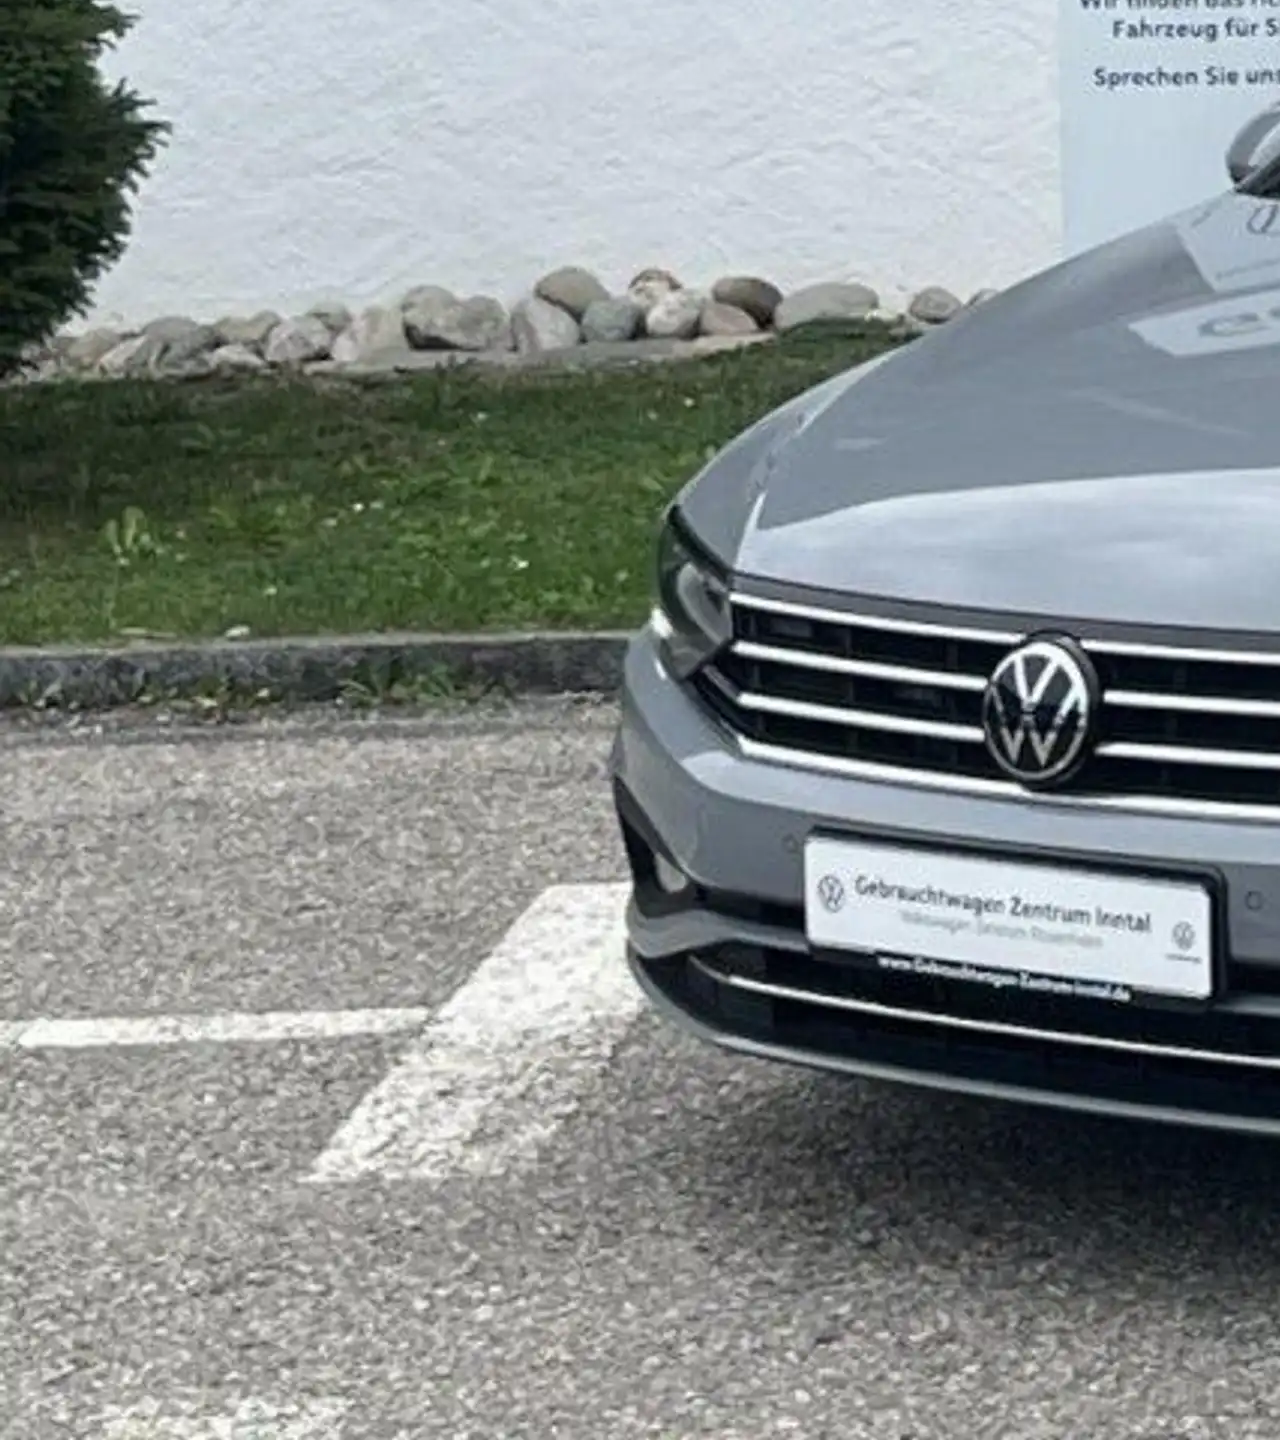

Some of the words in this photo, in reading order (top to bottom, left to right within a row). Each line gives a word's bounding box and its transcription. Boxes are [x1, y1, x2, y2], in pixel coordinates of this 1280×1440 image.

[1112, 19, 1218, 42] Fahrzeug
[1224, 17, 1260, 38] für
[1094, 67, 1198, 90] Sprechen
[1204, 66, 1239, 86] Sie
[854, 874, 1006, 917] Gebrauchtwagen
[1010, 896, 1091, 925] Zentrum
[1095, 906, 1152, 933] Inntal
